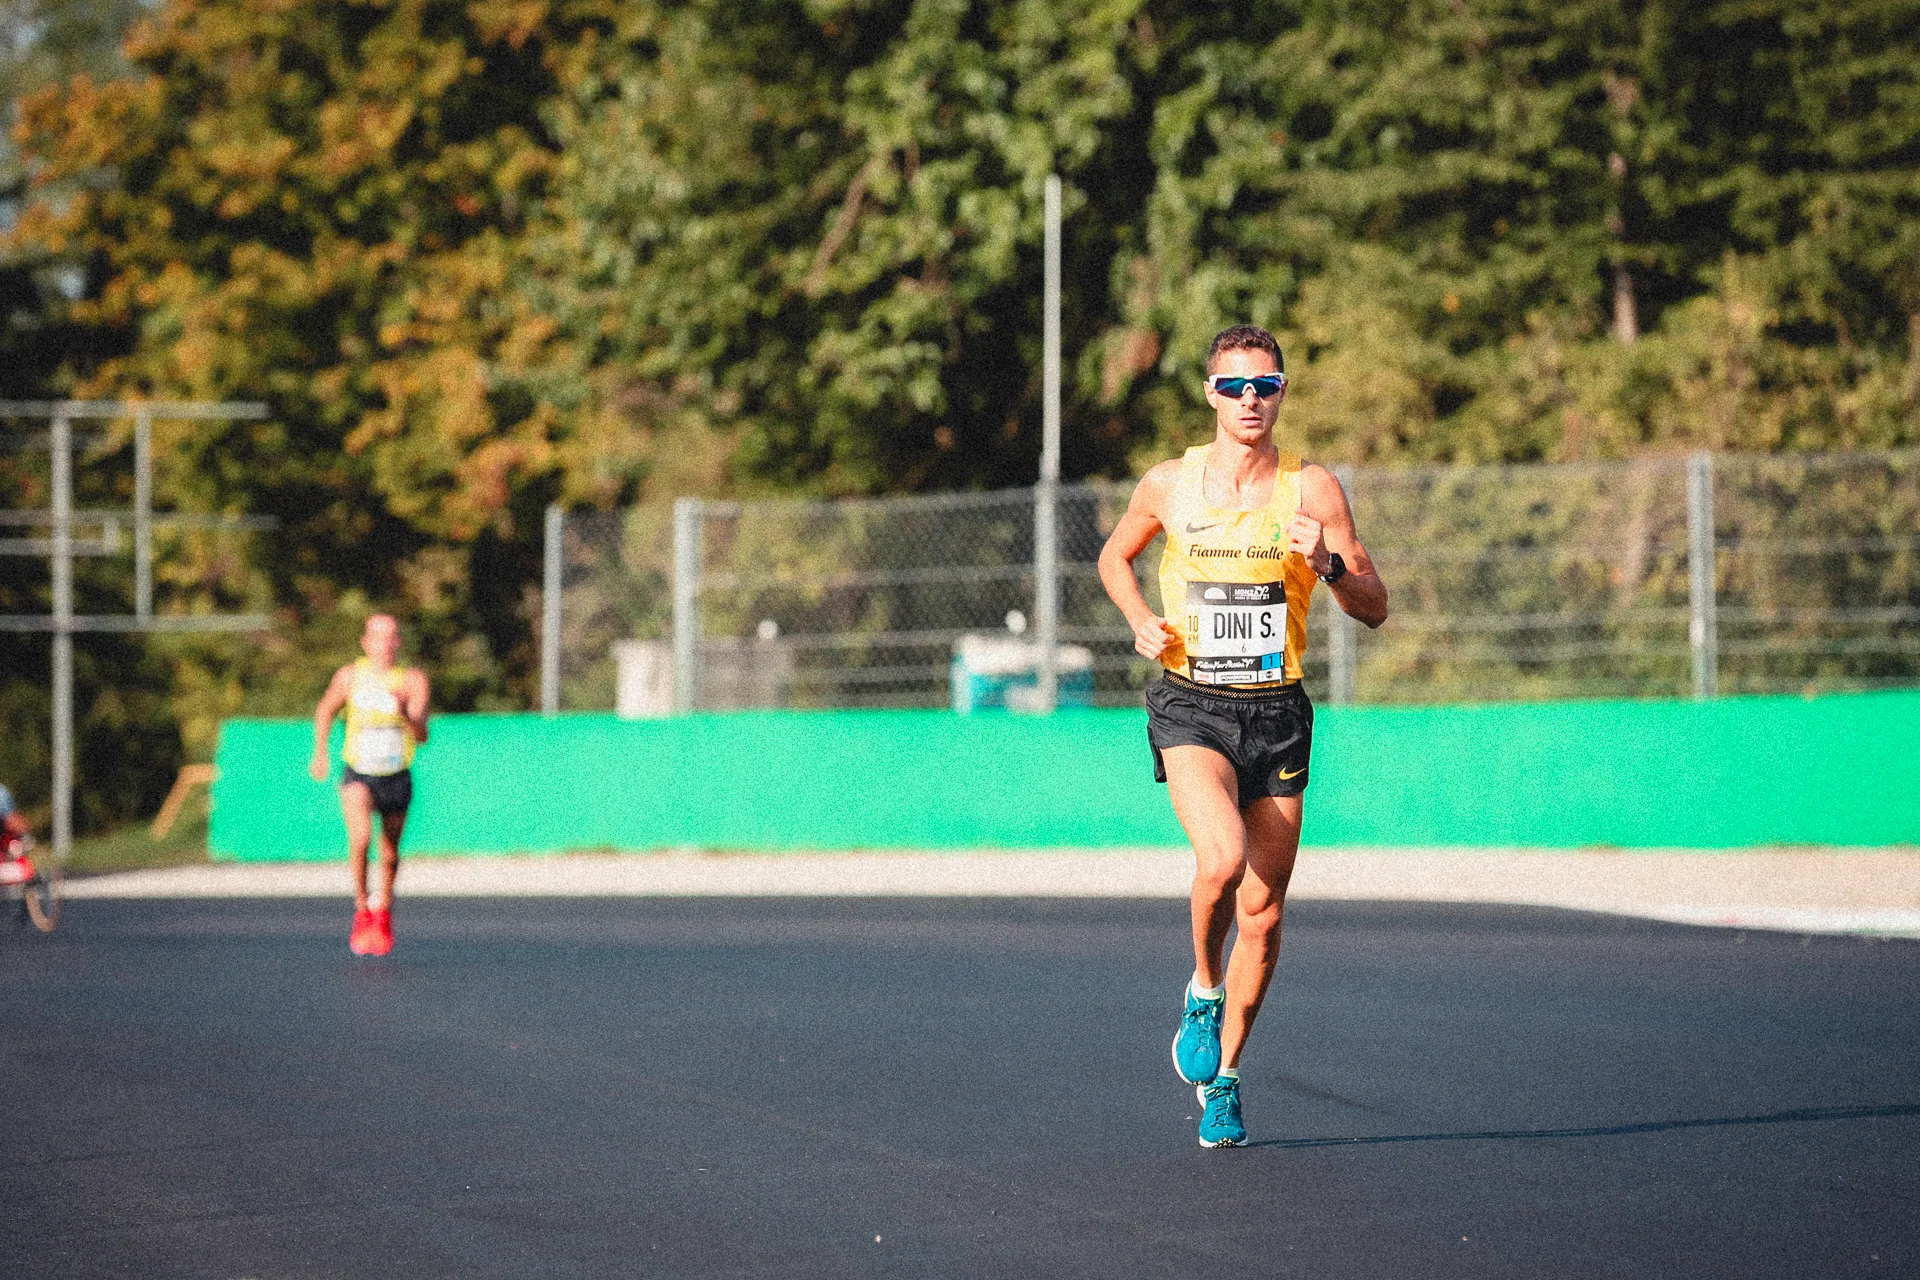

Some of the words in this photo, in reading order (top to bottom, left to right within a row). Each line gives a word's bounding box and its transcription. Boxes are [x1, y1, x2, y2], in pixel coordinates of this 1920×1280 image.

[1189, 544, 1241, 558] Fiamme
[1246, 545, 1284, 560] Gialle
[1188, 615, 1199, 632] 10
[1214, 612, 1252, 639] DINI
[1260, 611, 1276, 638] S.
[1241, 643, 1247, 653] 6
